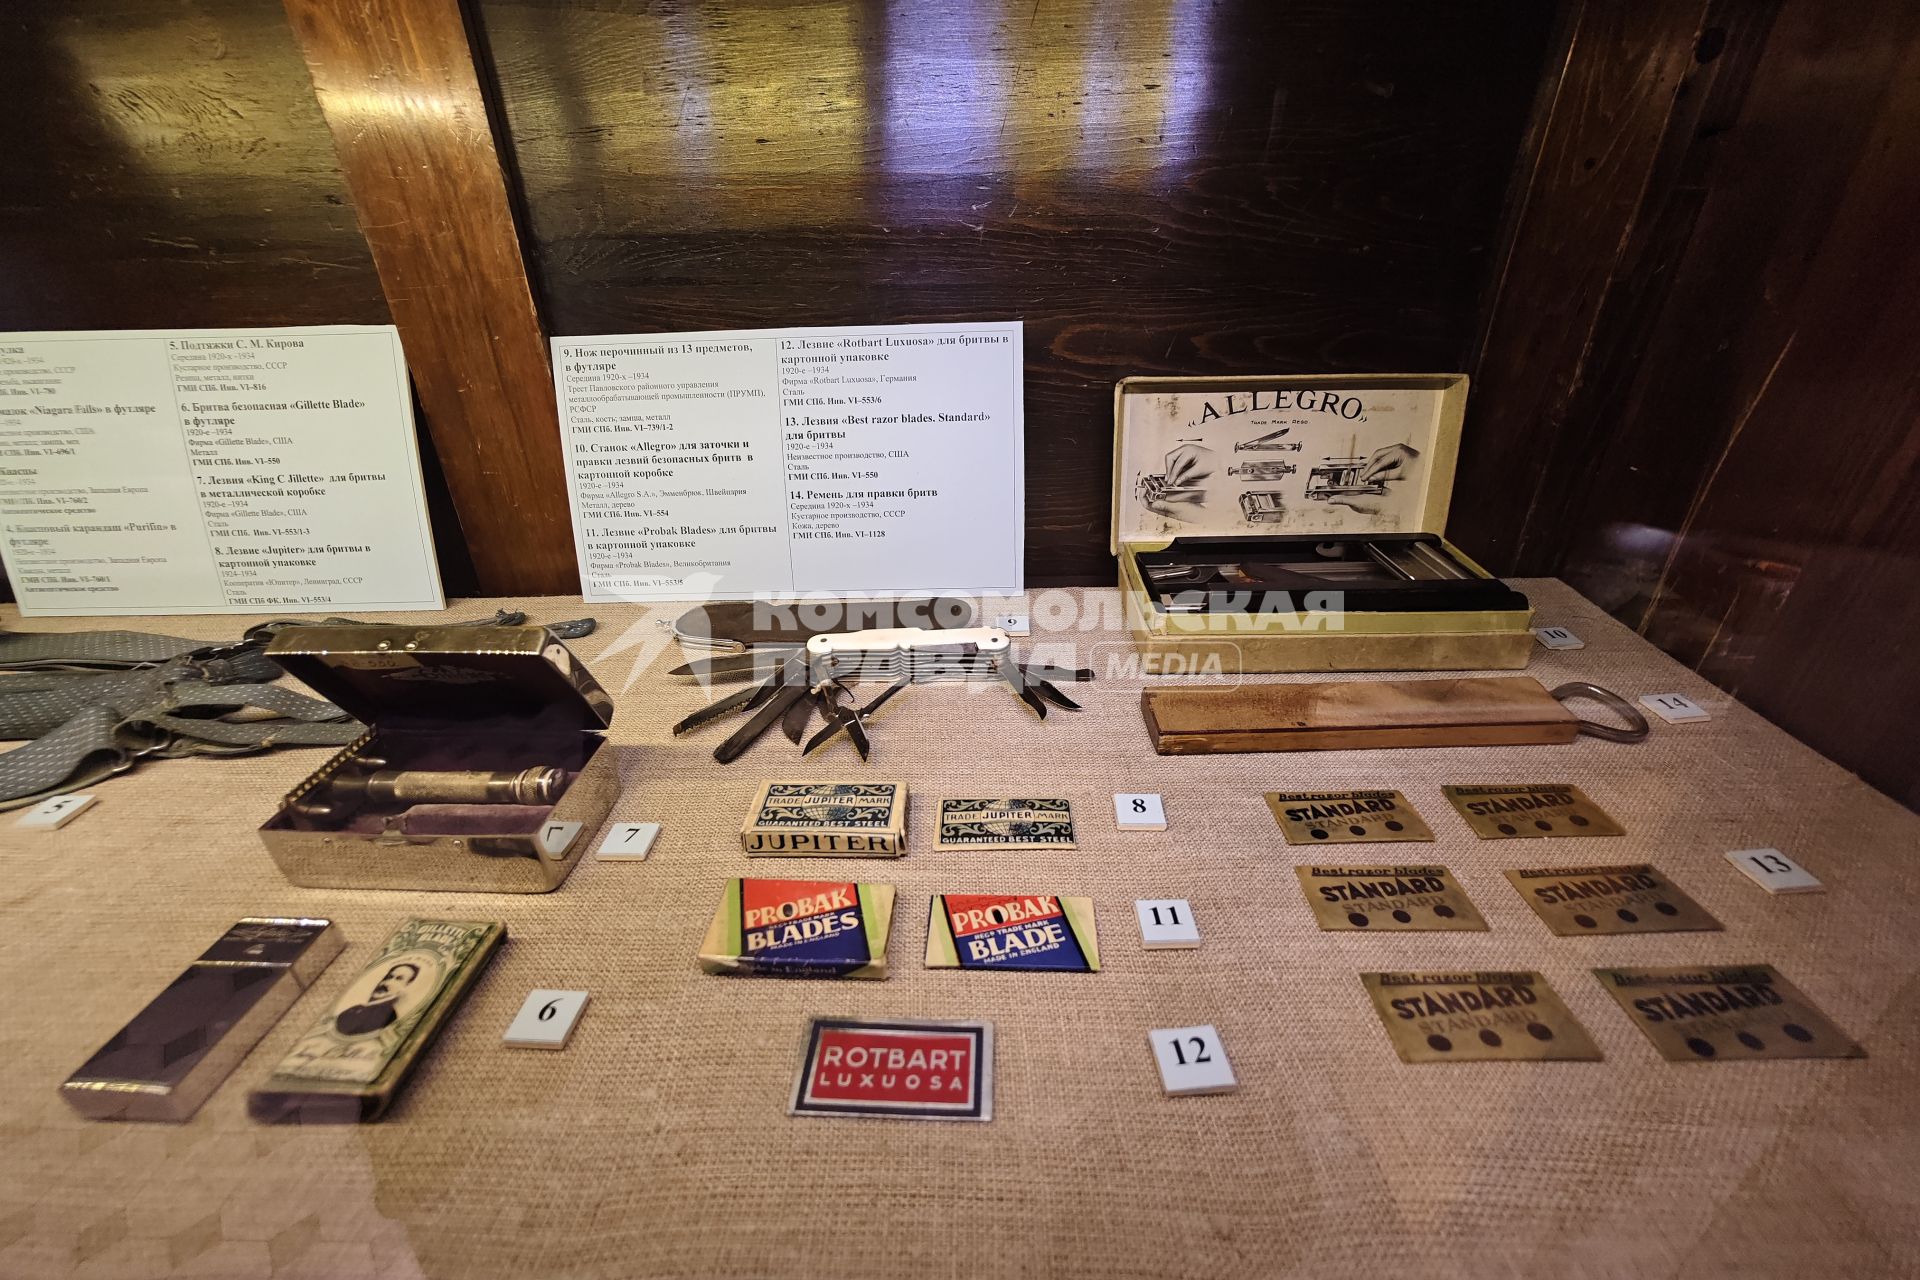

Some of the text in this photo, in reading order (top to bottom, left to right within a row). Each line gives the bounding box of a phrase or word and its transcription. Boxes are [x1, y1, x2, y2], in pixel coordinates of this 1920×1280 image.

[168, 338, 304, 350] 5. Подтяжки С. М. Кирова
[781, 340, 794, 349] 12.
[797, 339, 834, 349] Лезвие
[836, 337, 882, 347] «Rotbart
[885, 336, 934, 346] Luxuosa»
[936, 337, 955, 345] для
[958, 334, 999, 346] бритвы
[563, 348, 572, 357] 9.
[575, 348, 597, 357] Нож
[600, 347, 664, 358] перочинный
[682, 344, 692, 353] 13
[695, 344, 752, 355] предметов,
[573, 361, 616, 373] футляре
[781, 353, 889, 366] картонной упаковке
[180, 399, 365, 414] 6. Бритва безопасная «Gillette Blade»
[785, 416, 798, 426] 13.
[801, 415, 838, 425] Лезвия
[841, 415, 868, 424] «Best
[901, 413, 935, 423] blades.
[938, 411, 990, 422] Standard»
[806, 429, 845, 441] бритвы
[575, 444, 588, 452] 10.
[590, 443, 628, 452] Станок
[630, 441, 676, 452] «Allegro»
[678, 442, 696, 450] для
[699, 441, 739, 449] заточки
[576, 459, 612, 468] правки
[614, 455, 649, 464] лезвий
[651, 454, 709, 463] безопасных
[711, 452, 741, 464] бритв
[196, 476, 206, 485] 7.
[207, 475, 244, 484] Лезвия
[246, 474, 275, 485] «King
[276, 474, 285, 483] C
[287, 473, 324, 482] Jillette»
[348, 472, 385, 483] бритвы
[577, 468, 673, 481] картонной коробке
[790, 490, 803, 499] 14.
[806, 489, 843, 499] Ремень
[867, 490, 904, 500] правки
[907, 487, 937, 499] бритв
[586, 528, 599, 536] 11.
[601, 527, 635, 536] Лезвие
[637, 526, 677, 535] «Probak
[680, 525, 716, 535] Blades»
[738, 524, 776, 535] бритвы
[214, 547, 224, 555] 8.
[225, 546, 259, 555] Лезвие
[261, 545, 305, 556] «Jupiter»
[326, 544, 362, 555] бритвы
[595, 542, 647, 551] картонной
[650, 541, 695, 551] упаковке
[1547, 629, 1568, 640] 10
[1656, 697, 1689, 711] 14
[804, 796, 853, 804] JUPITER
[1132, 799, 1147, 814] 8
[1467, 793, 1575, 815] STANDARD
[982, 811, 1032, 819] JUPITER
[1037, 812, 1068, 820] MARK
[1285, 799, 1396, 822] STANDARD
[624, 828, 642, 844] 7
[751, 834, 890, 850] JUPITER
[1749, 855, 1793, 874] 13
[1320, 876, 1444, 902] STANDARD
[1534, 874, 1656, 903] STANDARD
[745, 888, 852, 929] PROBAK
[952, 896, 1060, 933] PROBAK
[1152, 904, 1177, 926] 11
[747, 911, 859, 952] BLADES
[998, 926, 1023, 934] TRADE
[1025, 920, 1049, 929] MARK
[968, 924, 1065, 960] BLADE
[984, 954, 1006, 964] MADE
[1020, 943, 1060, 956] ENGLAND
[538, 998, 564, 1022] 6
[1391, 986, 1536, 1019] STANDARD
[1633, 984, 1782, 1022] STANDARD
[823, 1044, 966, 1070] ROTBART
[1168, 1036, 1211, 1066] 12
[820, 1071, 963, 1091] LUXUOSA
